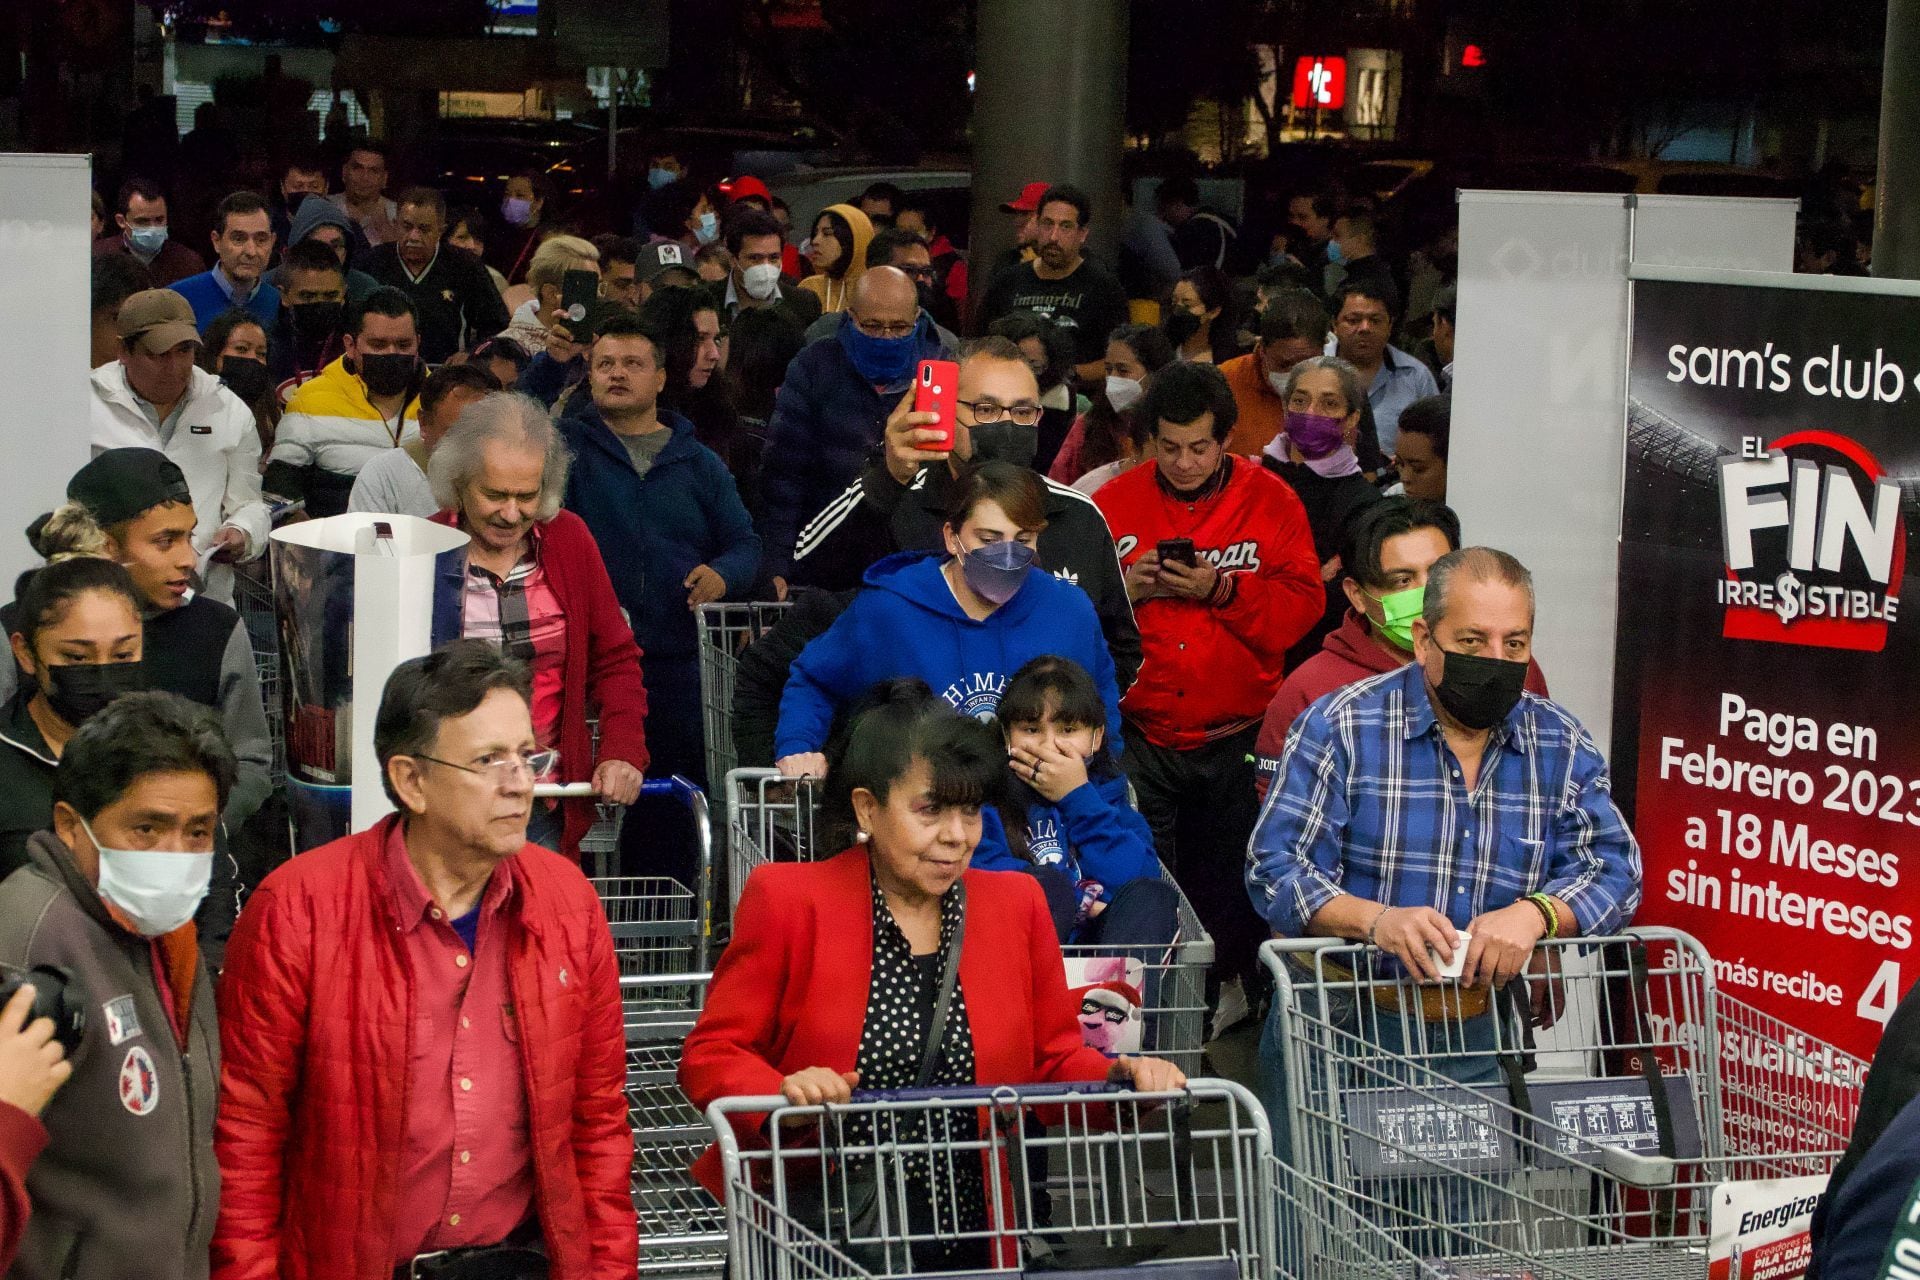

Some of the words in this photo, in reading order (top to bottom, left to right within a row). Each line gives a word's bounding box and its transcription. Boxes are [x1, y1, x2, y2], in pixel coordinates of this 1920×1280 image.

[1667, 342, 1791, 392] sam's
[1802, 344, 1905, 403] club
[1742, 436, 1770, 459] EL
[1717, 449, 1901, 584] FIN
[1720, 692, 1819, 757] Paga
[1826, 722, 1878, 761] en
[1660, 736, 1815, 805] Febrero
[1822, 764, 1920, 826] 2023
[1684, 816, 1707, 850] a
[1717, 808, 1762, 859] 18
[1769, 819, 1899, 888] Meses
[1666, 859, 1721, 910] sin
[1730, 868, 1912, 949] intereses
[1762, 970, 1843, 1006] recibe
[1857, 960, 1901, 1031] 4
[1799, 1127, 1829, 1147] con
[1755, 1238, 1801, 1259] Creadores
[1784, 1247, 1801, 1260] DE
